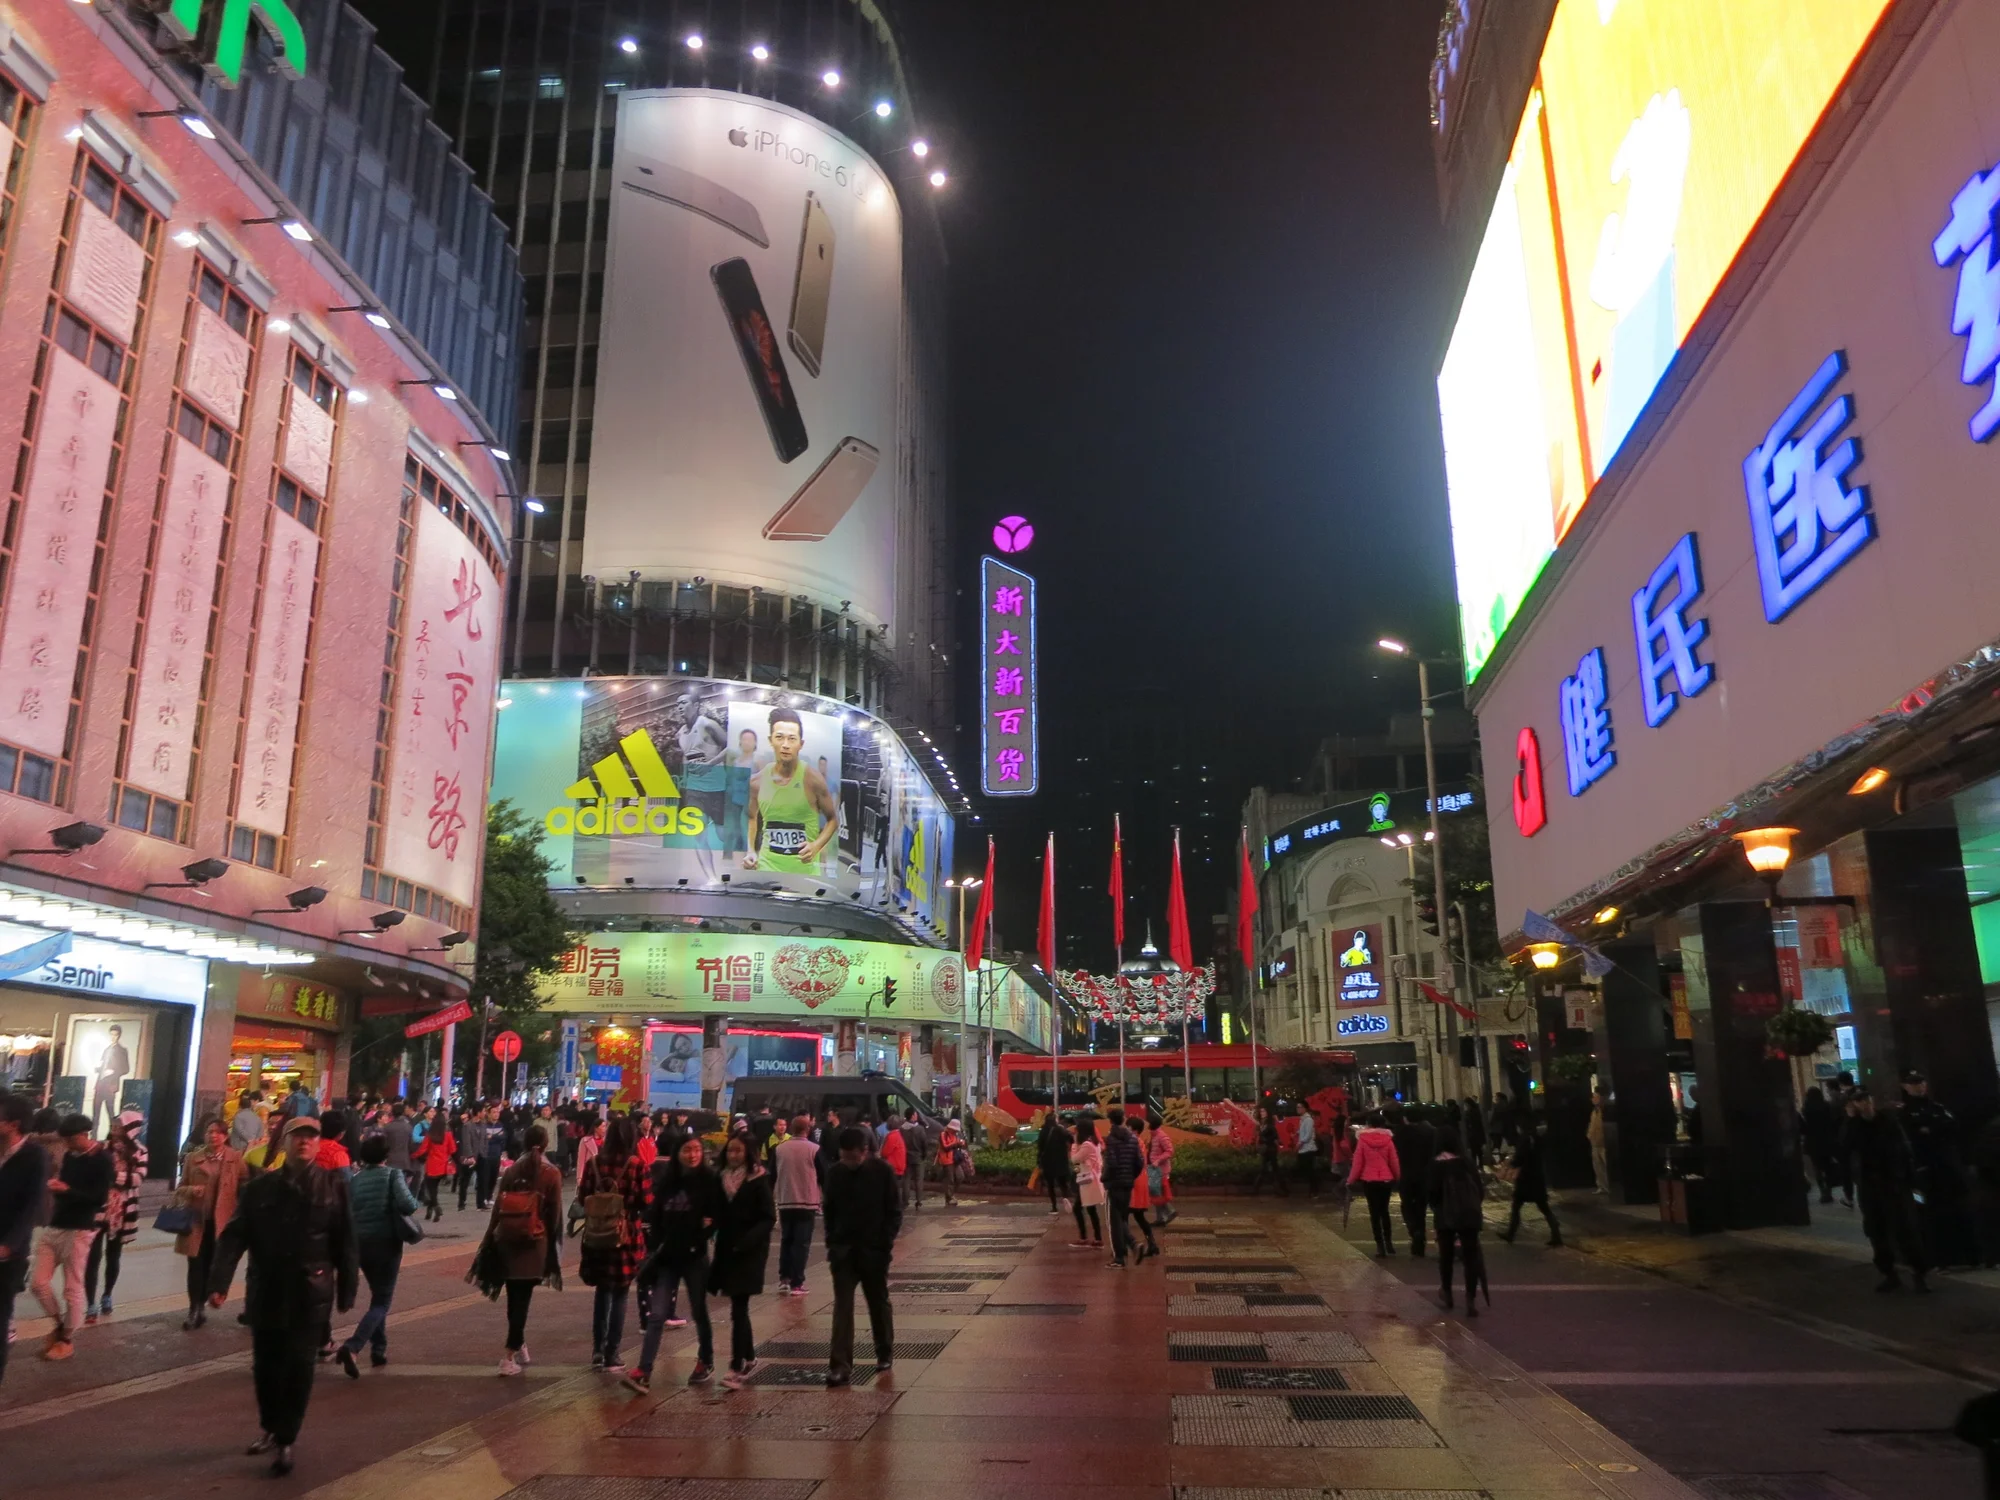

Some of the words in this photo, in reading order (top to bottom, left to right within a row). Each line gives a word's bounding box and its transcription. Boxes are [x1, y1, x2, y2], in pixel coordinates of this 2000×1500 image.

[754, 128, 832, 178] iPhone
[991, 585, 1025, 782] 新大新百货
[427, 557, 483, 861] 北京路
[544, 798, 705, 836] adidas
[43, 959, 114, 989] Semir
[588, 979, 624, 997] 是福
[695, 955, 751, 993] 节俭
[1337, 1013, 1388, 1036] adidas
[753, 1059, 799, 1072] SINOMAX
